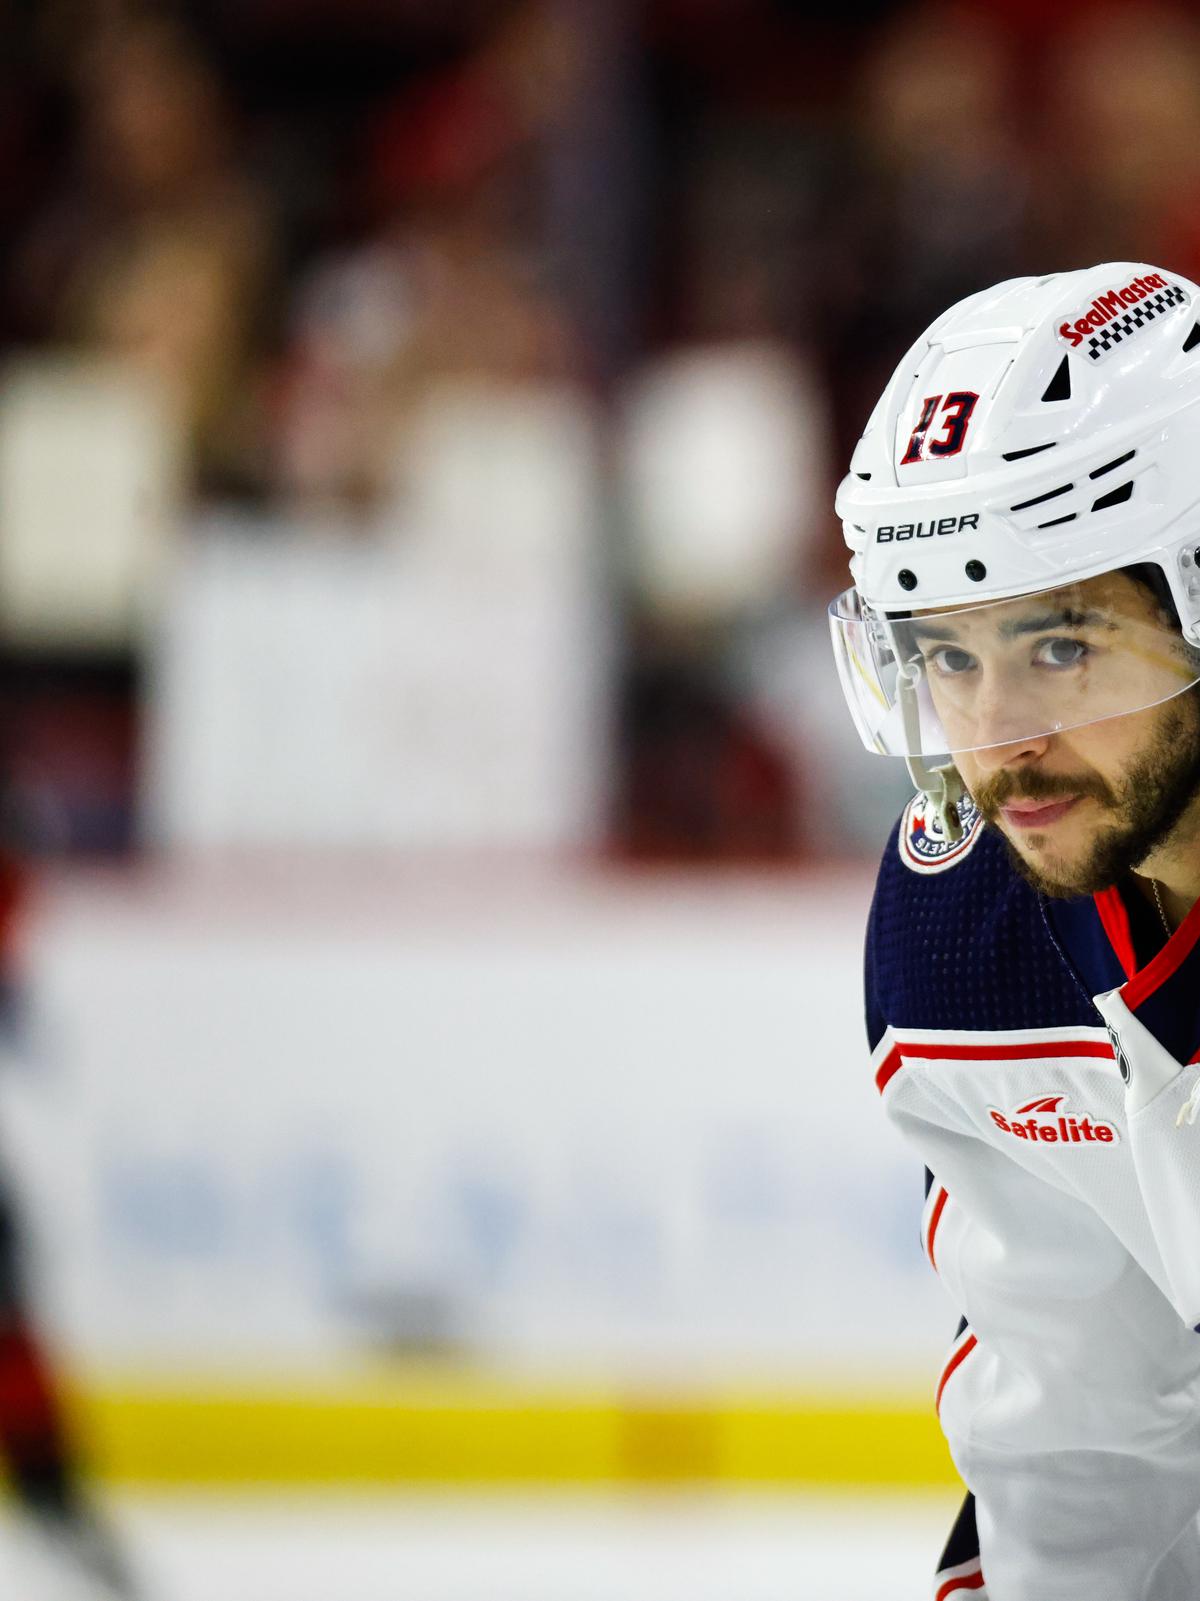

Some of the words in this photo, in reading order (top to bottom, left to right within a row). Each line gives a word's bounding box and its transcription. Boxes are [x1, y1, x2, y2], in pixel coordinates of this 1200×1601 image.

[1059, 273, 1168, 347] SealMaster
[900, 391, 980, 465] 13
[876, 513, 980, 543] BAUER
[990, 1111, 1114, 1142] Safelite
